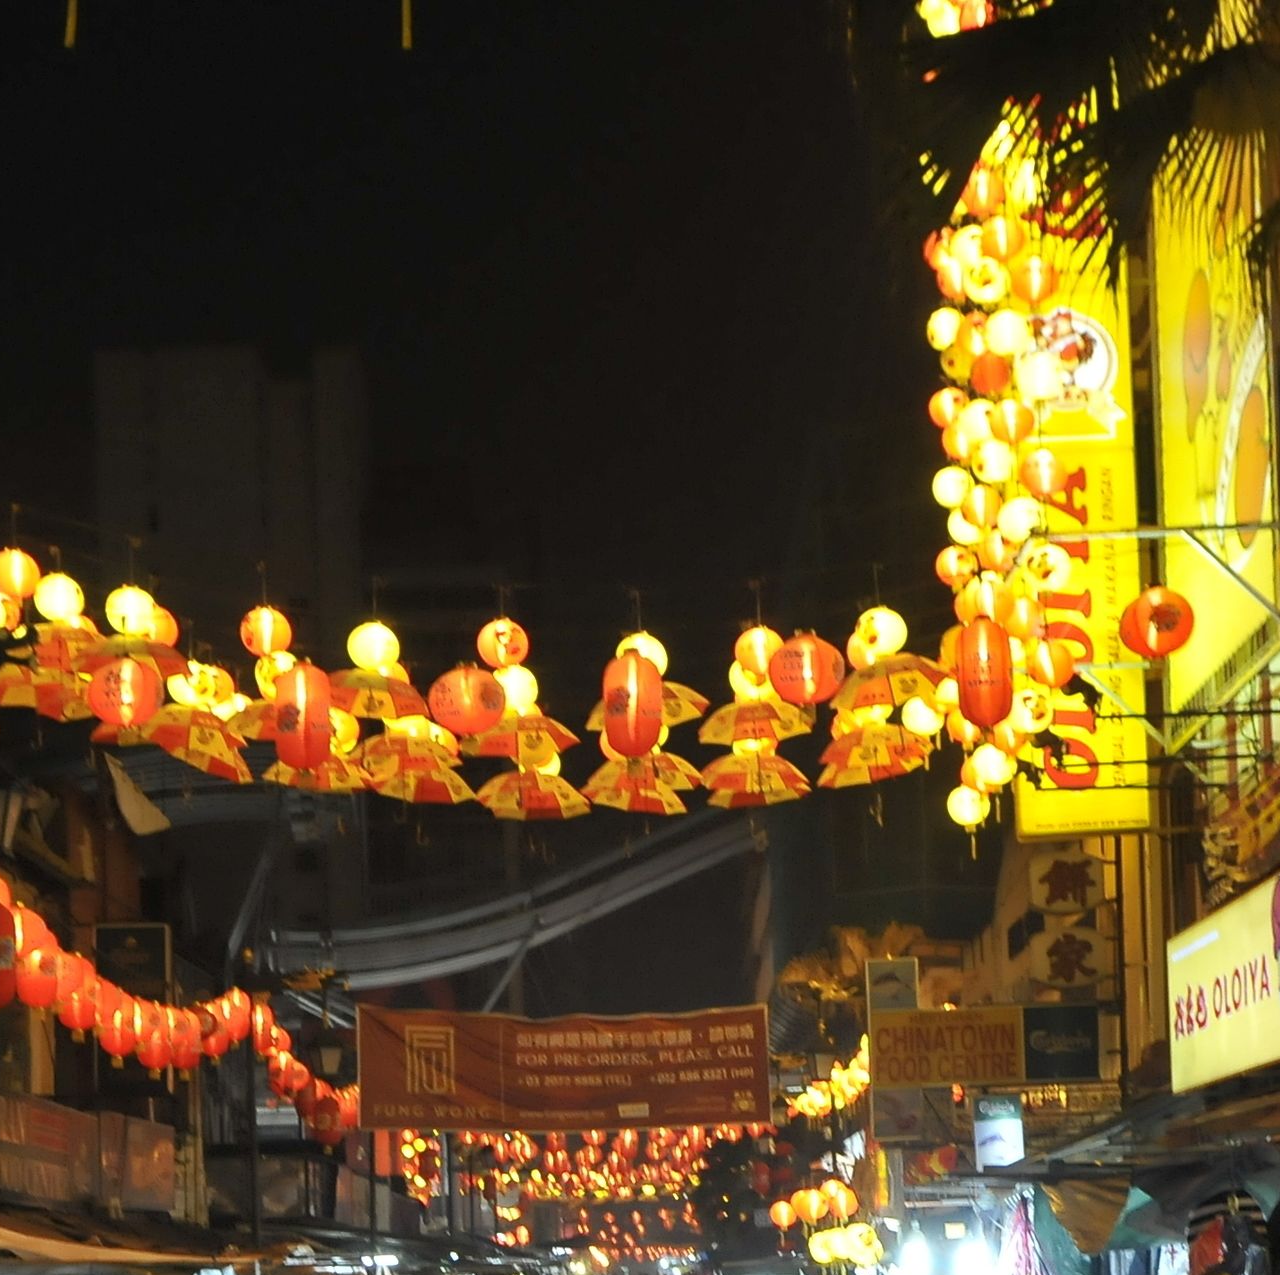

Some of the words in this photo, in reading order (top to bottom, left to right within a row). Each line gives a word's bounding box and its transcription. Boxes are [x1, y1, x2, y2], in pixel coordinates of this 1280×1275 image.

[1213, 955, 1270, 1019] OLOIYA
[875, 1023, 1016, 1054] CHINATOWN
[516, 1053, 548, 1067] FOR
[659, 1047, 713, 1063] PLEASE
[716, 1044, 754, 1059] CALL
[938, 1051, 1018, 1081] CENTRE
